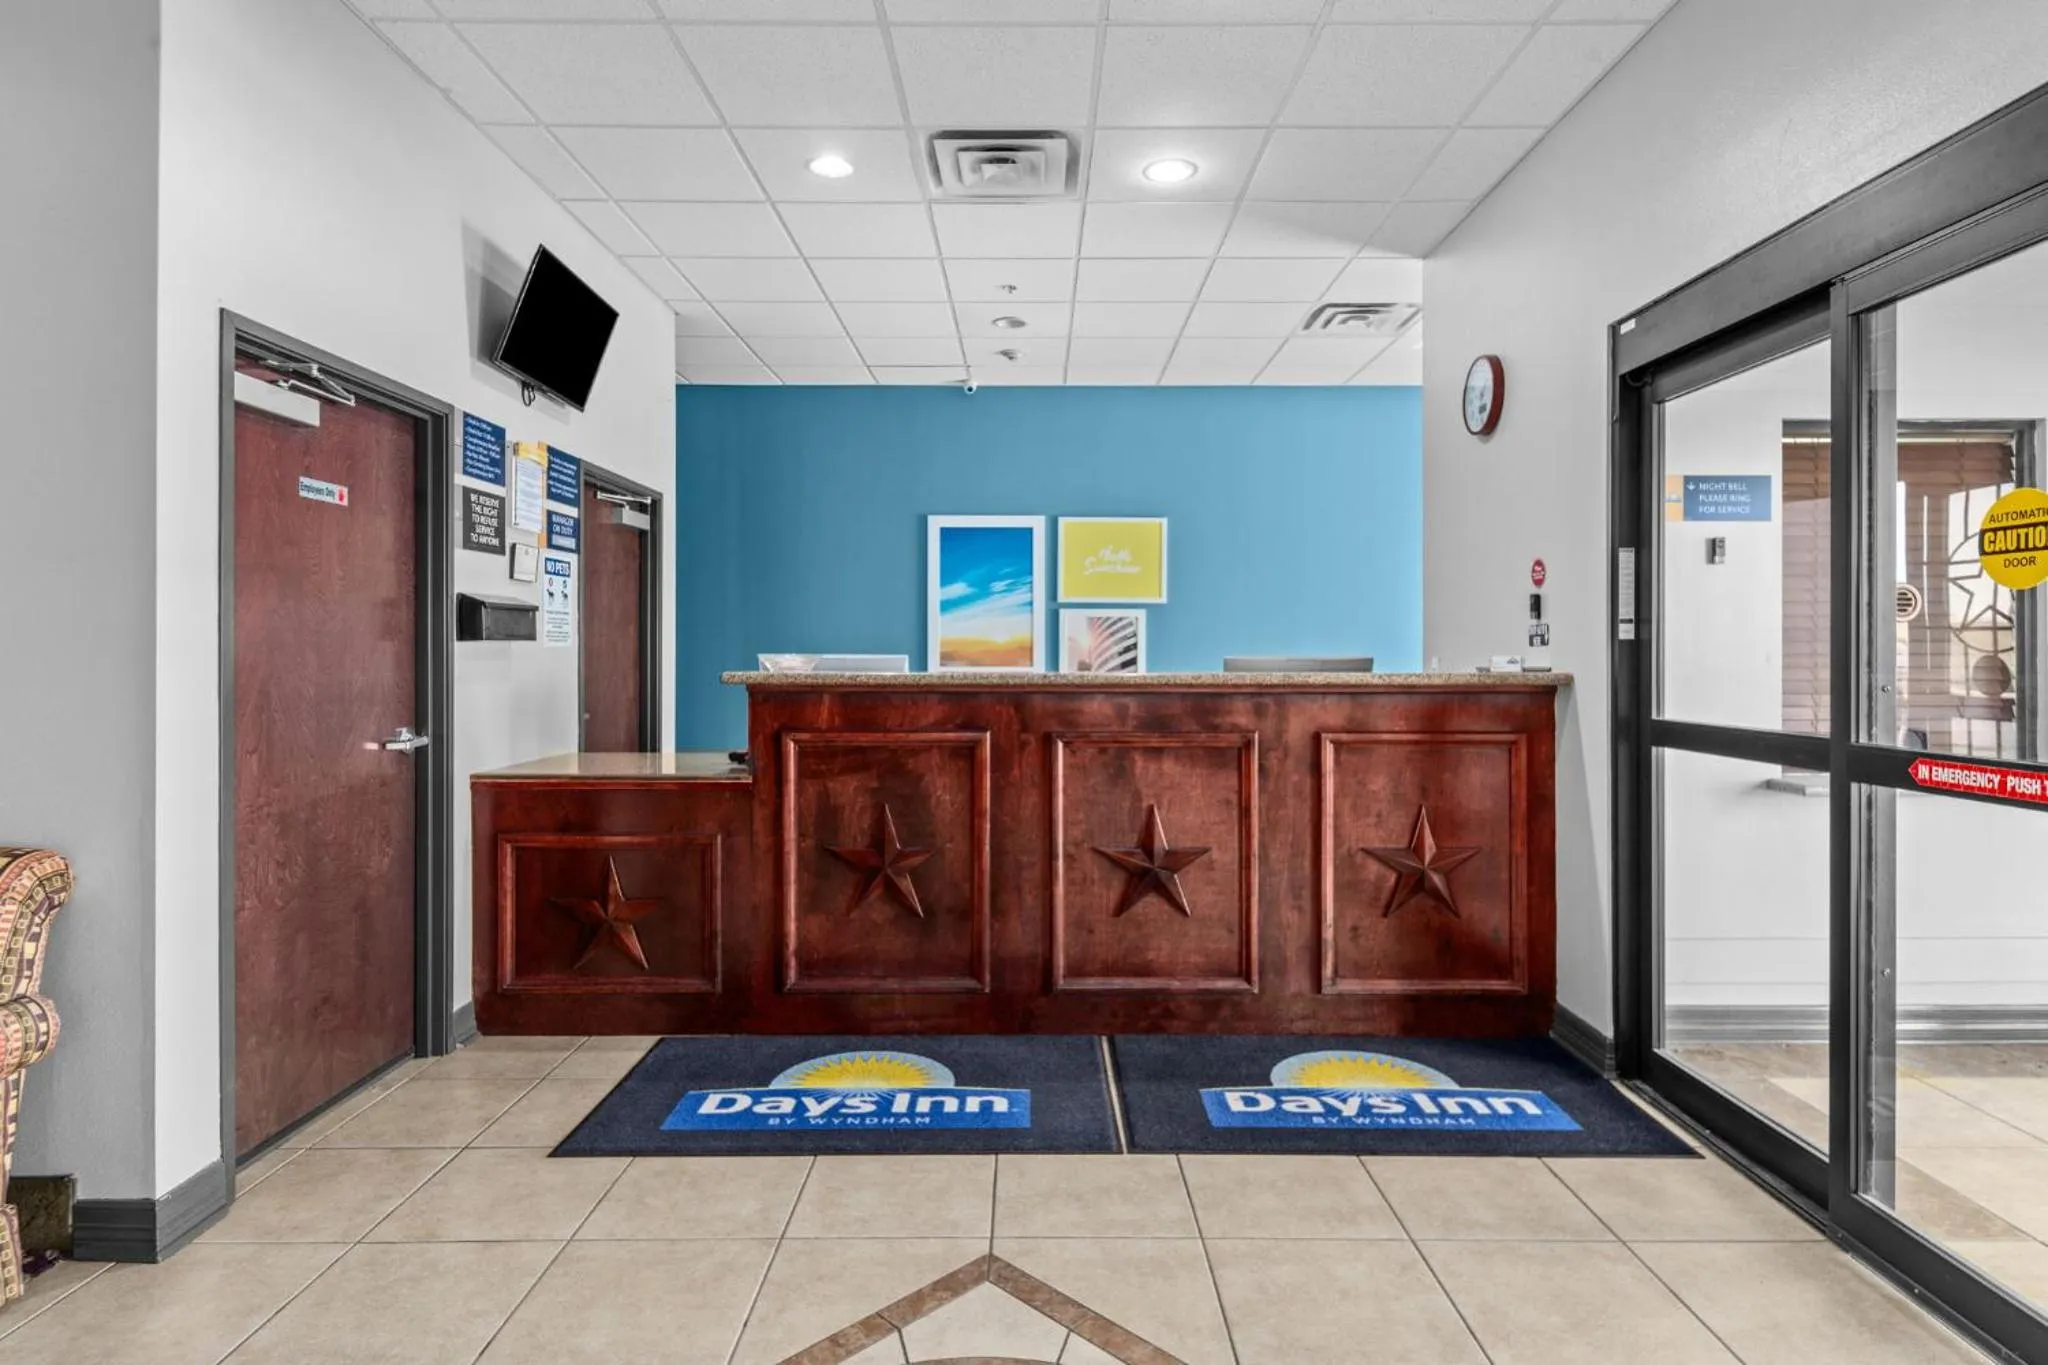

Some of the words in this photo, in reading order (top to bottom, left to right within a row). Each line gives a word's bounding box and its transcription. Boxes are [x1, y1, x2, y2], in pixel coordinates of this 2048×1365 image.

[1699, 482, 1725, 491] NIGHT
[1728, 482, 1747, 491] BELL
[1699, 494, 1727, 503] PLEASE
[1729, 494, 1752, 503] RING
[472, 503, 483, 514] THE
[483, 506, 498, 518] RIGHT
[1699, 505, 1716, 514] FOR
[1718, 505, 1750, 514] SERVICE
[472, 513, 480, 523] TO
[480, 515, 498, 527] REFUSE
[475, 524, 495, 536] SERVICE
[470, 532, 479, 543] TO
[479, 535, 499, 547] ANYONE
[1983, 525, 2048, 553] CAUTIO
[546, 560, 555, 573] NO
[2003, 556, 2037, 568] DOOR
[1918, 763, 1930, 780] IN
[1931, 766, 2001, 790] EMERGENCY
[2006, 775, 2041, 796] PUSH
[697, 1093, 877, 1117] Days
[891, 1093, 1009, 1113] Inn
[1224, 1091, 1407, 1117] Days
[1411, 1093, 1543, 1115] Inn
[768, 1117, 797, 1125] BY
[809, 1117, 931, 1125] WYNDHAM
[1311, 1116, 1339, 1124] BY
[1352, 1116, 1476, 1125] WYNDHAM
